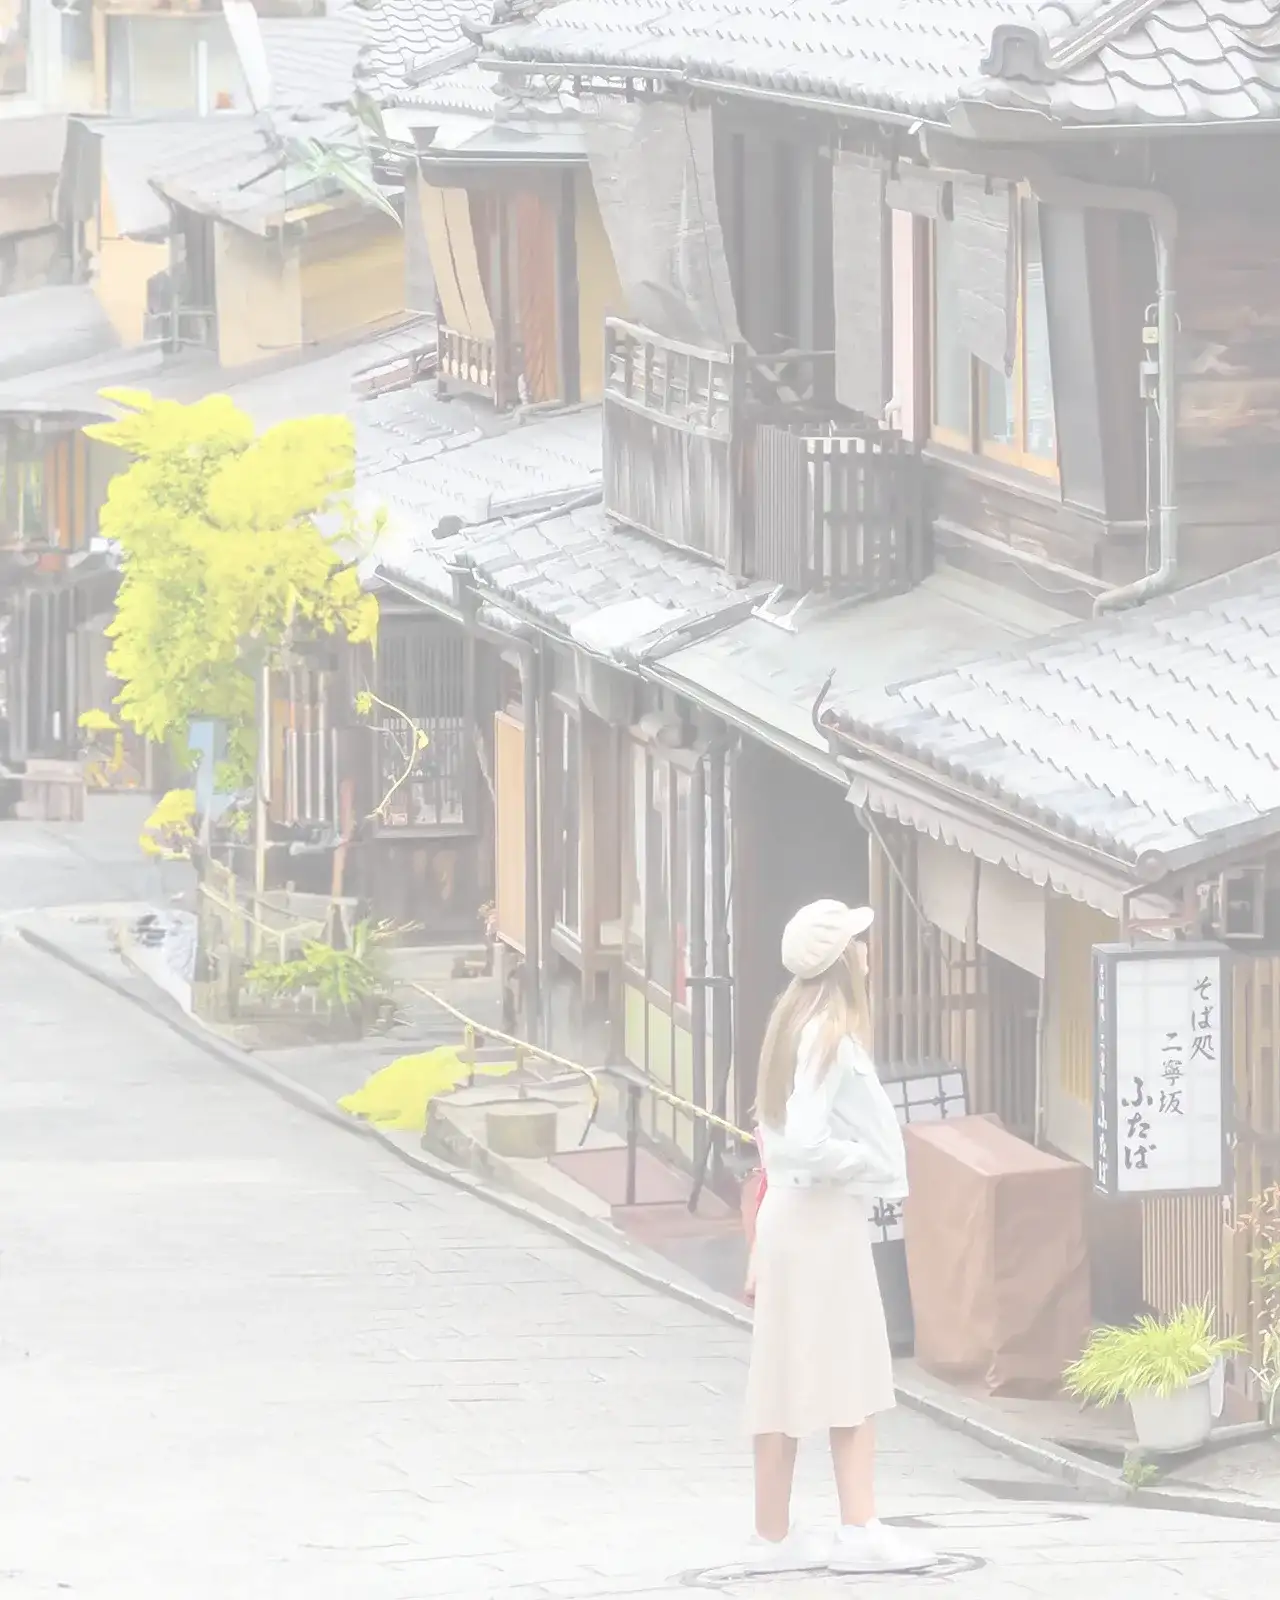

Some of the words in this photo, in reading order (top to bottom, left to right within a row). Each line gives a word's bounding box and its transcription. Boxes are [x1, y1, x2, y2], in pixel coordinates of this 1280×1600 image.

[1189, 975, 1217, 1061] そば処
[1157, 1031, 1185, 1116] 二寧坂
[1120, 1076, 1157, 1171] ふたば
